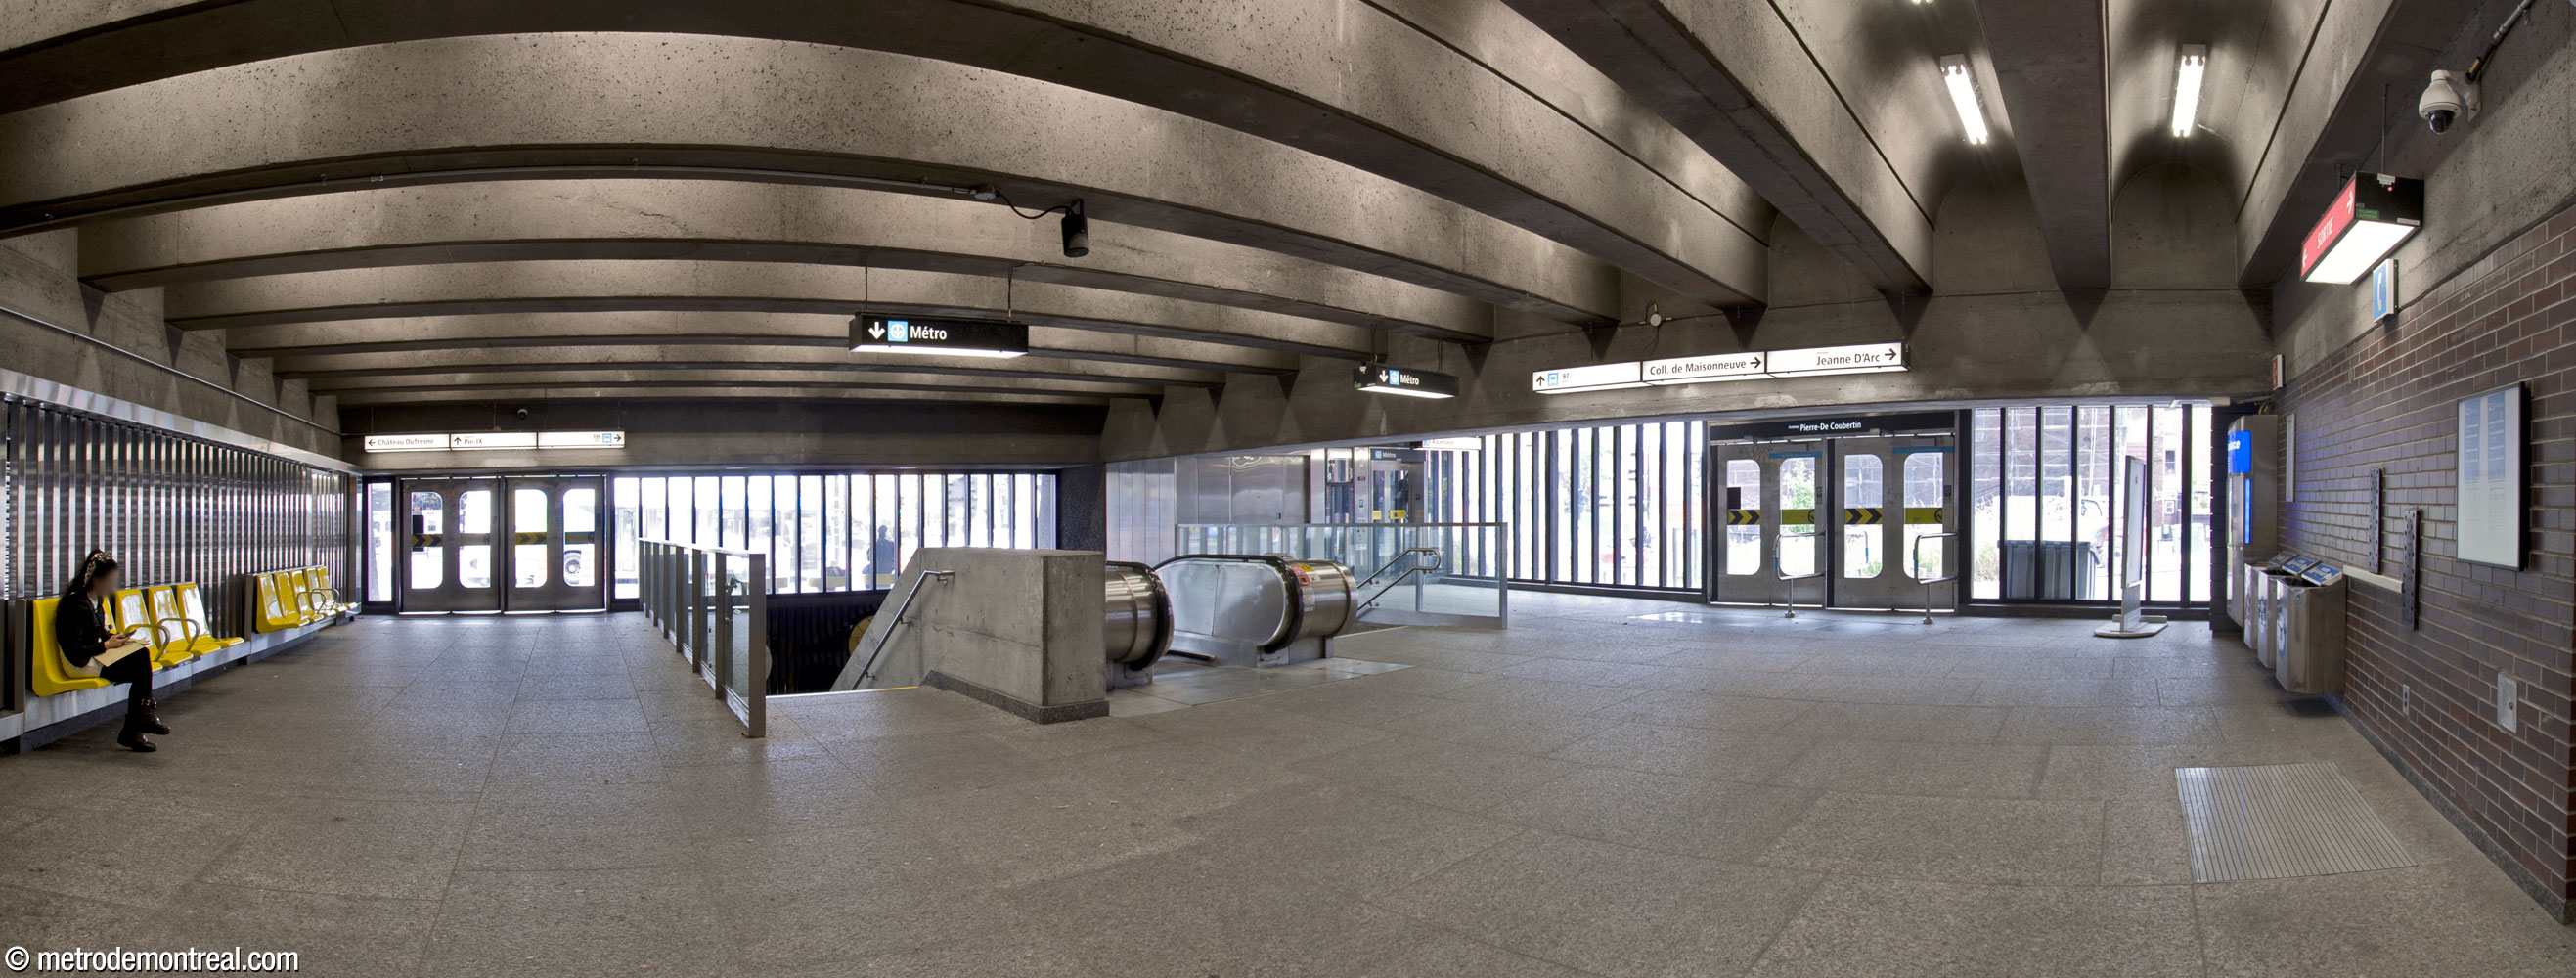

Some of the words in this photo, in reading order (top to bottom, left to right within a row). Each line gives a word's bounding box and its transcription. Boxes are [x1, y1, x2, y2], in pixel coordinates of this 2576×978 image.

[2316, 215, 2334, 249] SORTIE
[910, 325, 948, 340] Métro
[1816, 356, 1851, 366] Jeanne
[1650, 365, 1669, 376] Coll.
[1671, 364, 1683, 374] de
[1685, 361, 1747, 372] Maisonneuve
[1399, 374, 1420, 385] Métro
[1799, 422, 1829, 431] Pierre-De
[1830, 421, 1862, 430] Coubertin
